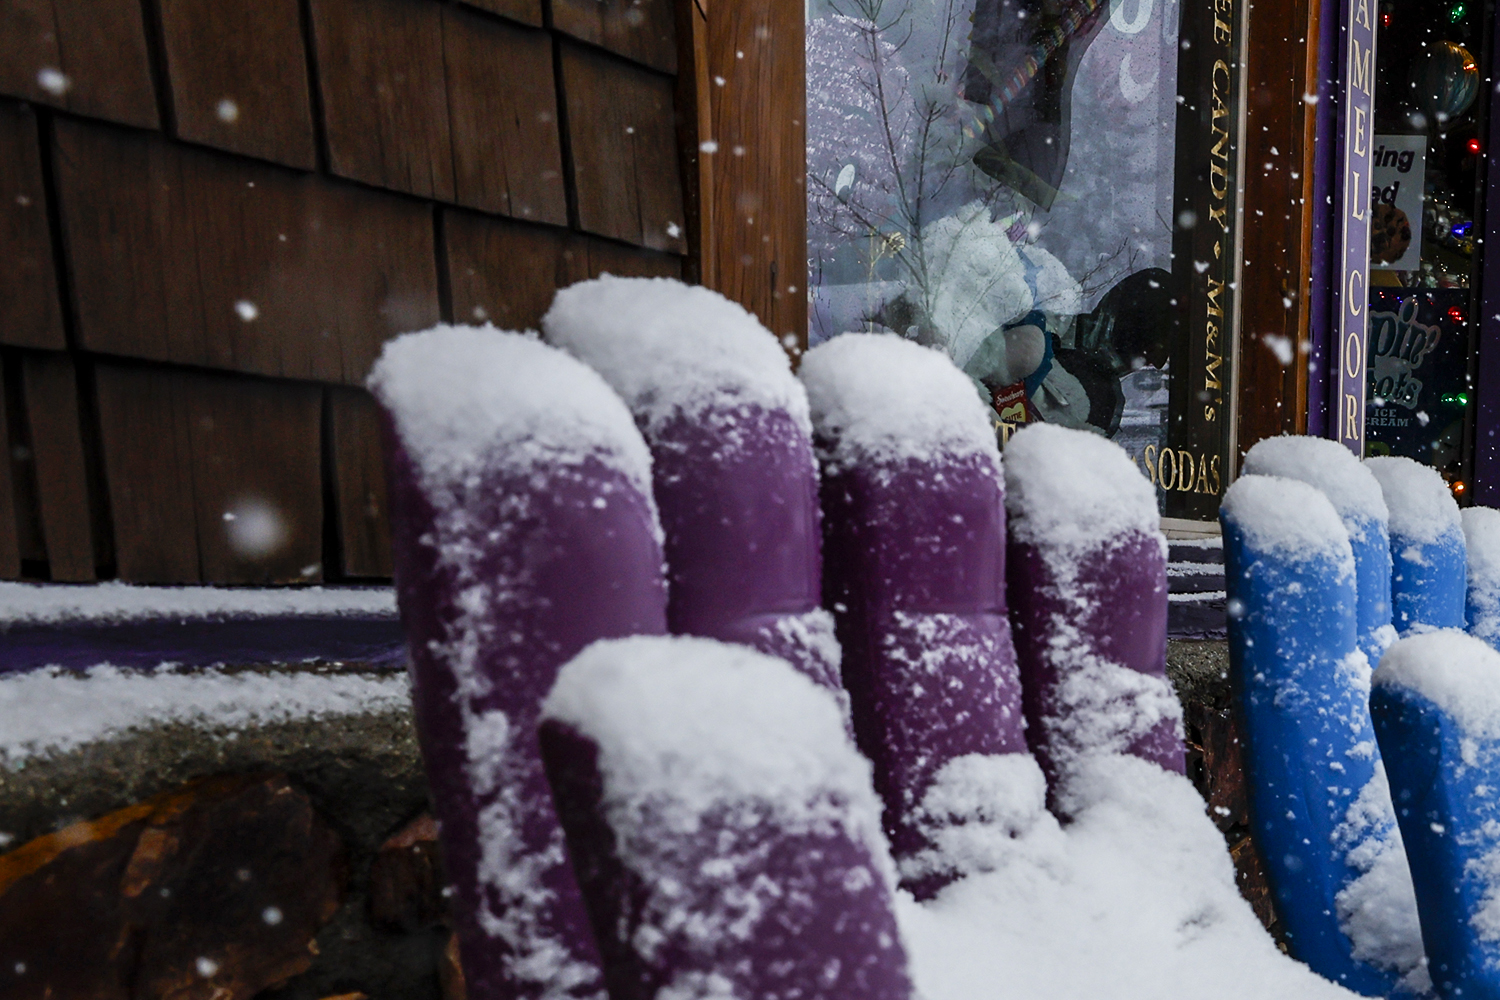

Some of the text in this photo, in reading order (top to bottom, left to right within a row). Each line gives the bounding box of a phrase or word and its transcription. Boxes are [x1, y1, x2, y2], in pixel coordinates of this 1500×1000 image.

[1209, 59, 1231, 231] CANDY
[1205, 275, 1225, 422] M&M's
[1374, 408, 1397, 418] ICE
[1144, 445, 1221, 495] SODAS
